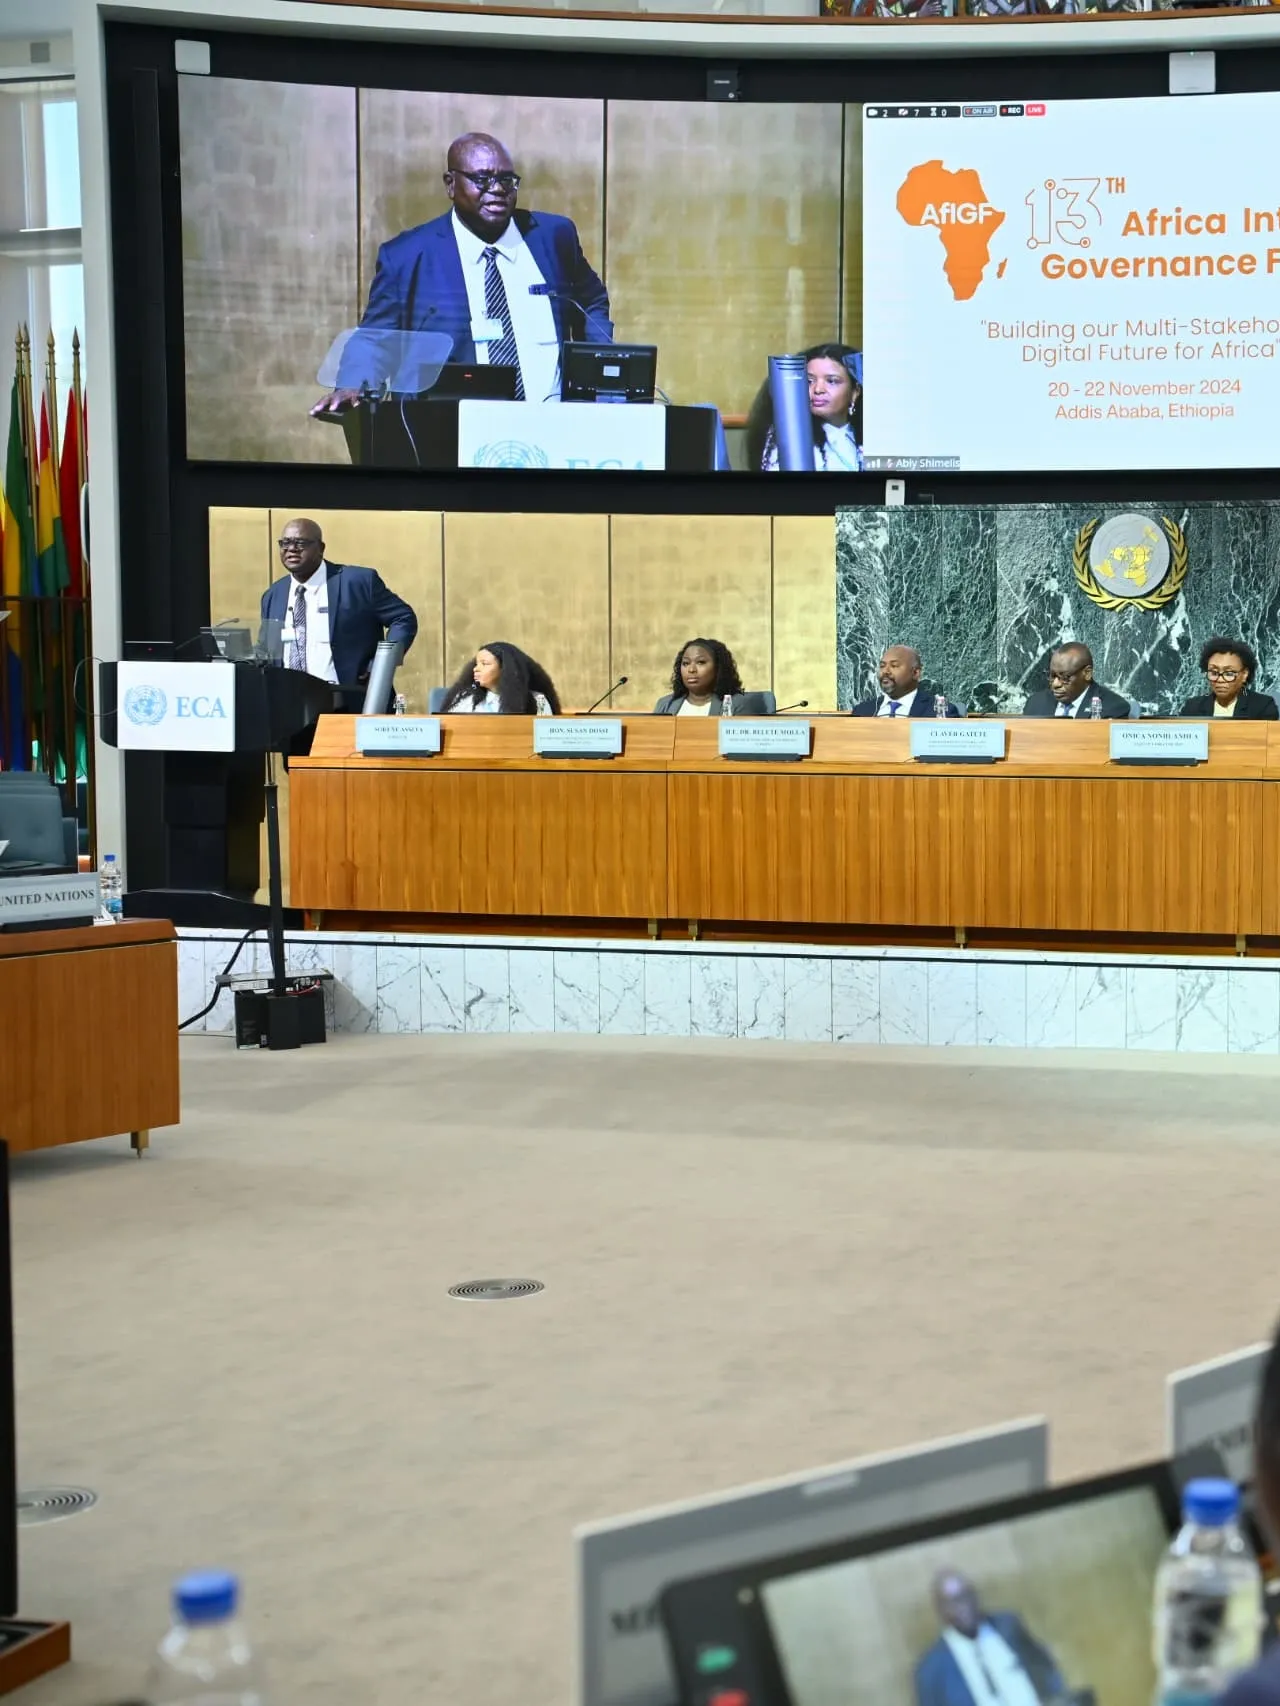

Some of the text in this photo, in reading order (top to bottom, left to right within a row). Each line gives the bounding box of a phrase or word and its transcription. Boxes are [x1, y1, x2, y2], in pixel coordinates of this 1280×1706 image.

[1007, 106, 1021, 114] REC
[1027, 106, 1043, 114] LIVE
[920, 201, 993, 225] AfIGF
[1121, 206, 1226, 237] Africa
[1041, 252, 1257, 280] Governance
[1082, 322, 1119, 338] our
[1022, 343, 1091, 368] Digital
[1099, 343, 1168, 361] Future
[1174, 341, 1204, 361] for
[1048, 382, 1069, 397] 20
[1084, 381, 1105, 396] 22
[1109, 380, 1196, 396] November
[1200, 378, 1242, 395] 2024
[1055, 402, 1235, 421] Addis Ababa, Ethiopia
[920, 457, 960, 469] Shimelis
[175, 696, 228, 719] ECA
[44, 889, 95, 905] NATIONS
